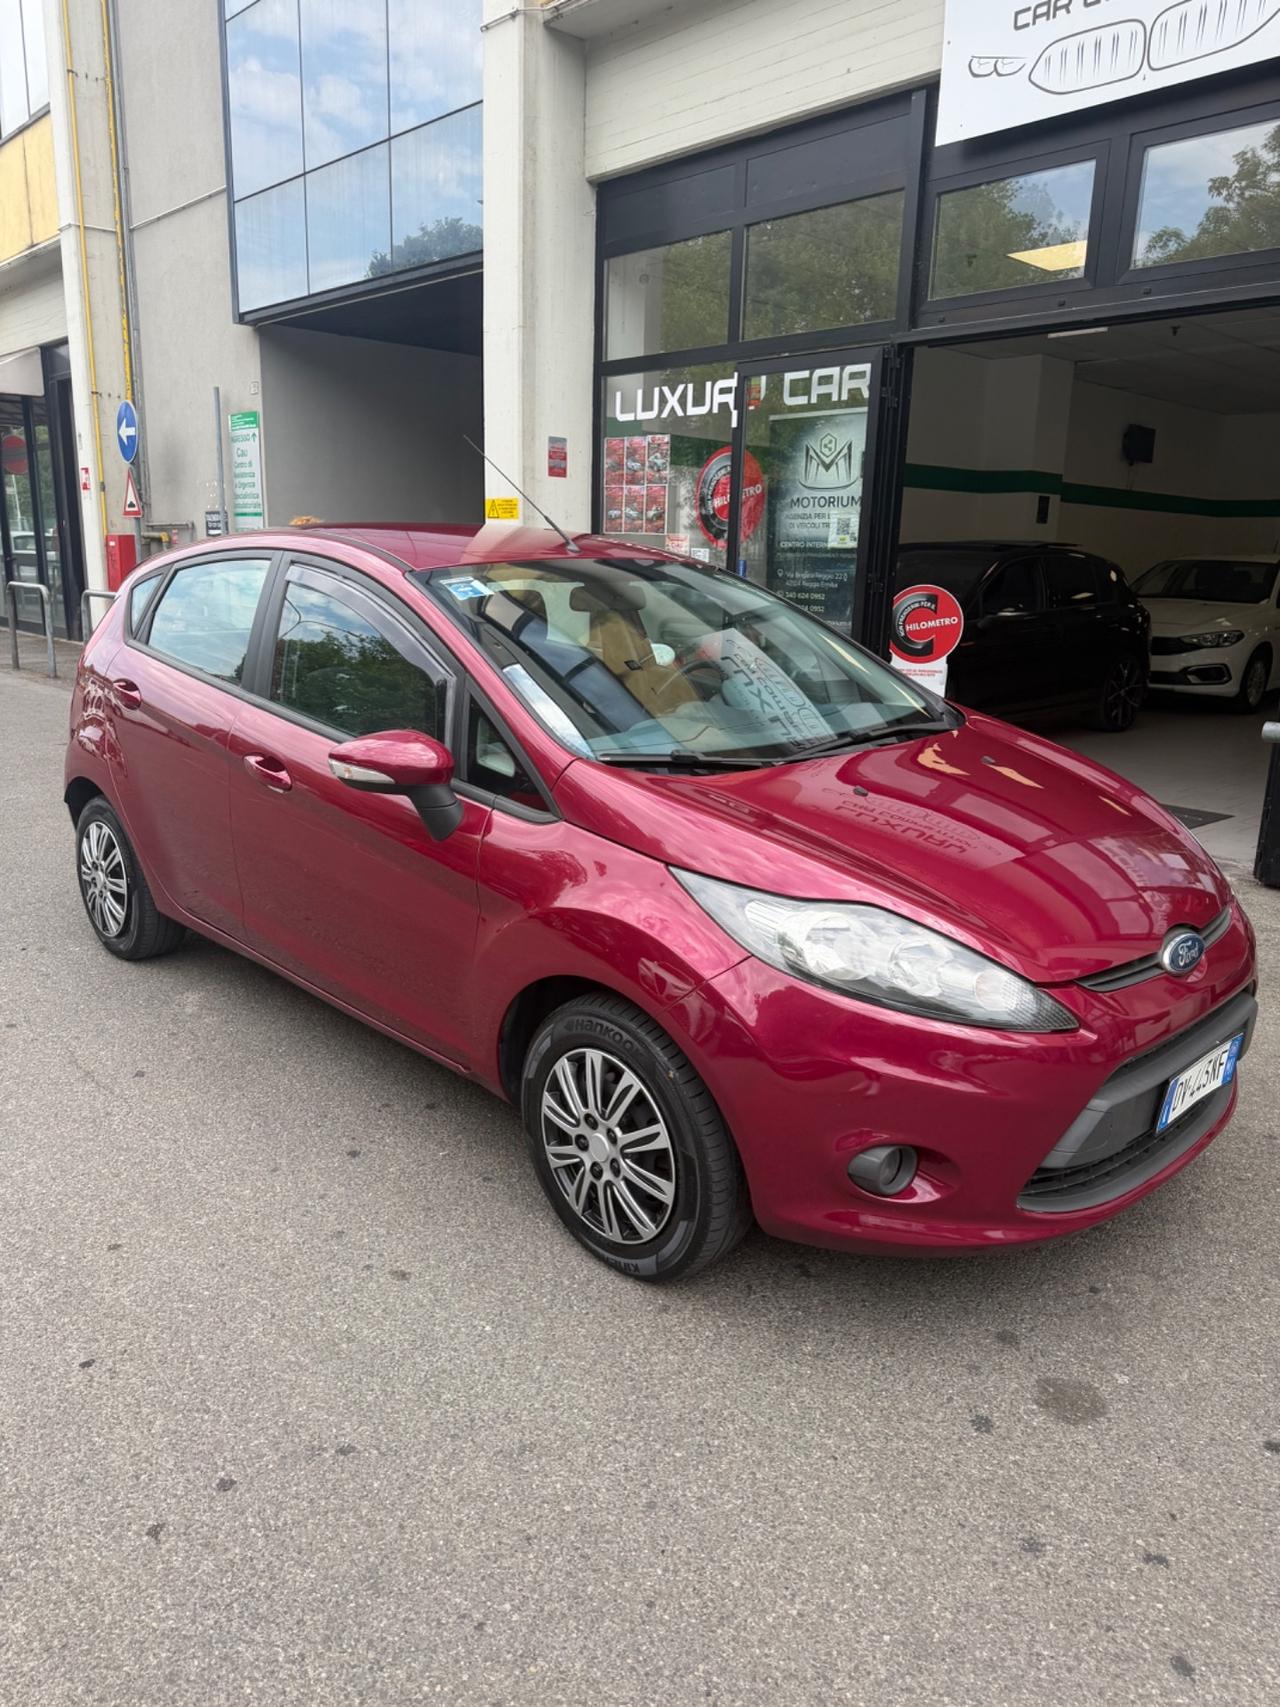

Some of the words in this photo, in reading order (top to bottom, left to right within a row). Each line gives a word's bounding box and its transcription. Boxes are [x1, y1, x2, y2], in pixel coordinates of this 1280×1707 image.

[1013, 0, 1072, 31] CAR
[783, 363, 872, 406] CAR
[790, 495, 862, 509] MOTORIUM
[1178, 940, 1199, 966] Ford
